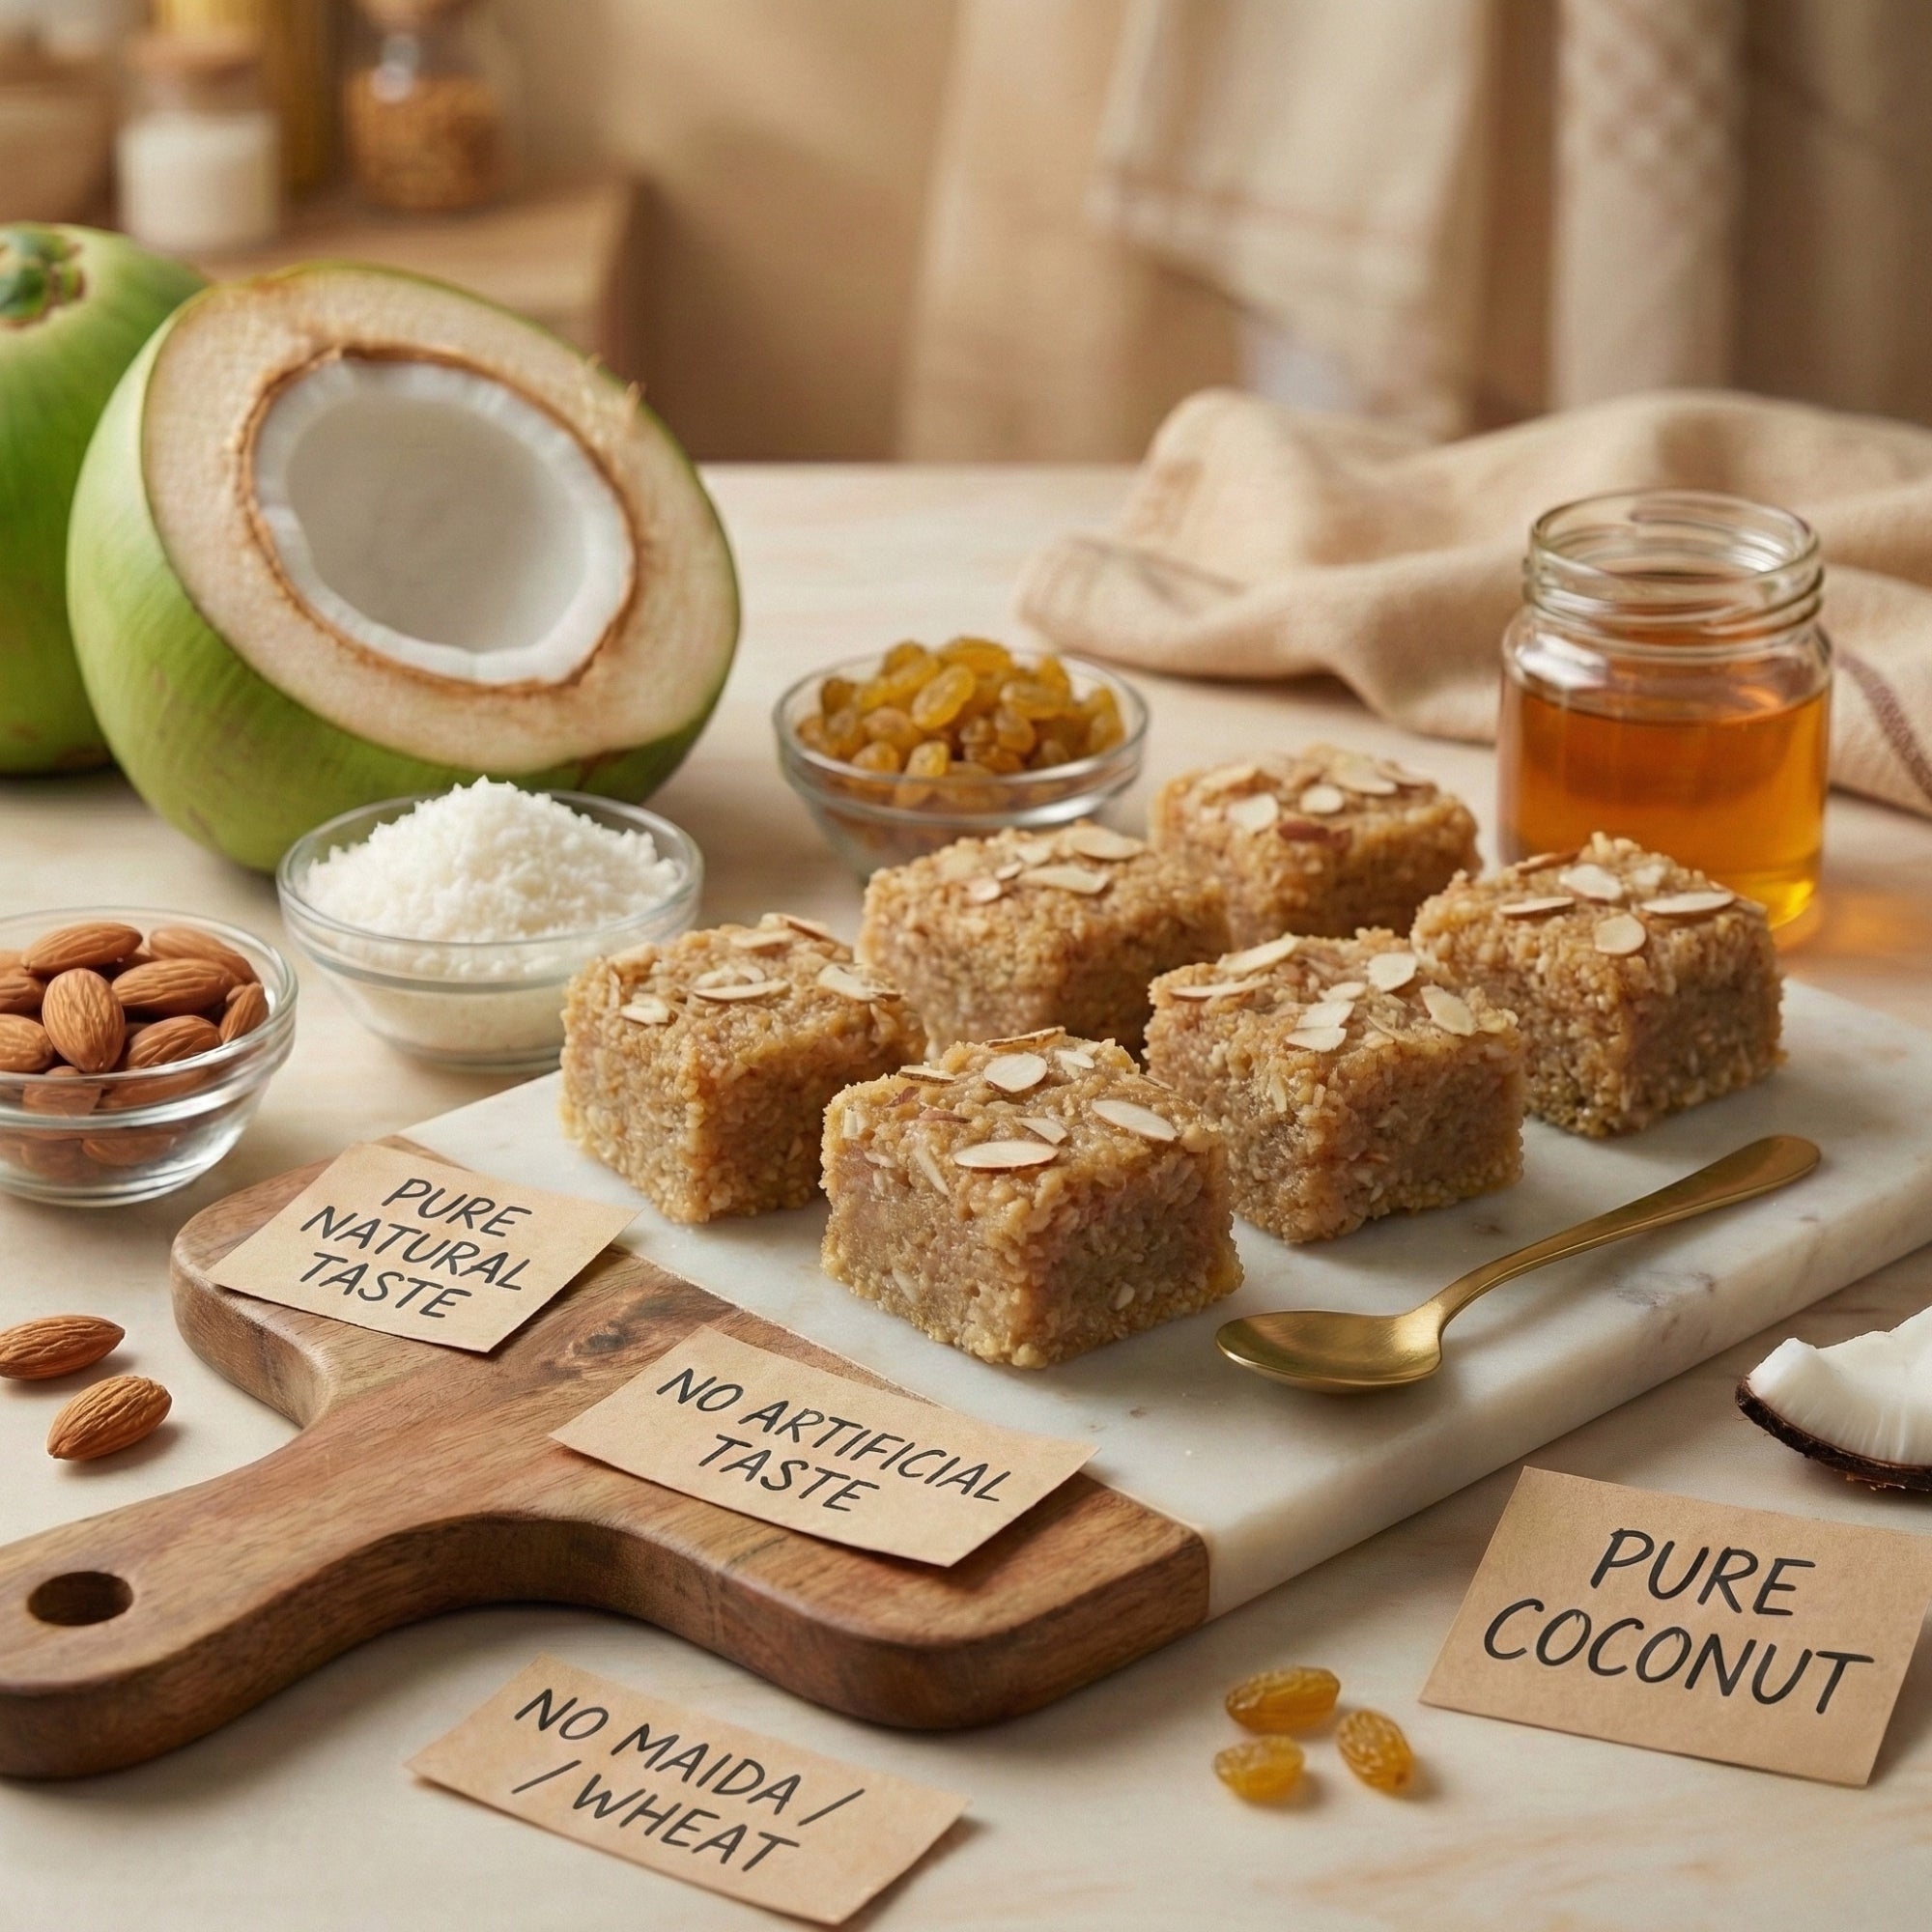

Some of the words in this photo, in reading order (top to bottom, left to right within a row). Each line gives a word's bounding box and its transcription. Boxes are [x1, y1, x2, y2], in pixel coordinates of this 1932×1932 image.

[299, 1205, 531, 1292] NATURAL
[381, 1178, 533, 1238] PURE
[298, 1251, 473, 1320] TASTE
[655, 1367, 745, 1413] NO
[737, 1399, 1012, 1503] ARTIFICIAL
[697, 1433, 881, 1513] TASTE
[1589, 1526, 1817, 1617] PURE
[1483, 1597, 1876, 1716] COCONUT
[513, 1688, 610, 1741] NO
[610, 1721, 802, 1816] MAIDA
[572, 1773, 801, 1873] WHEAT
